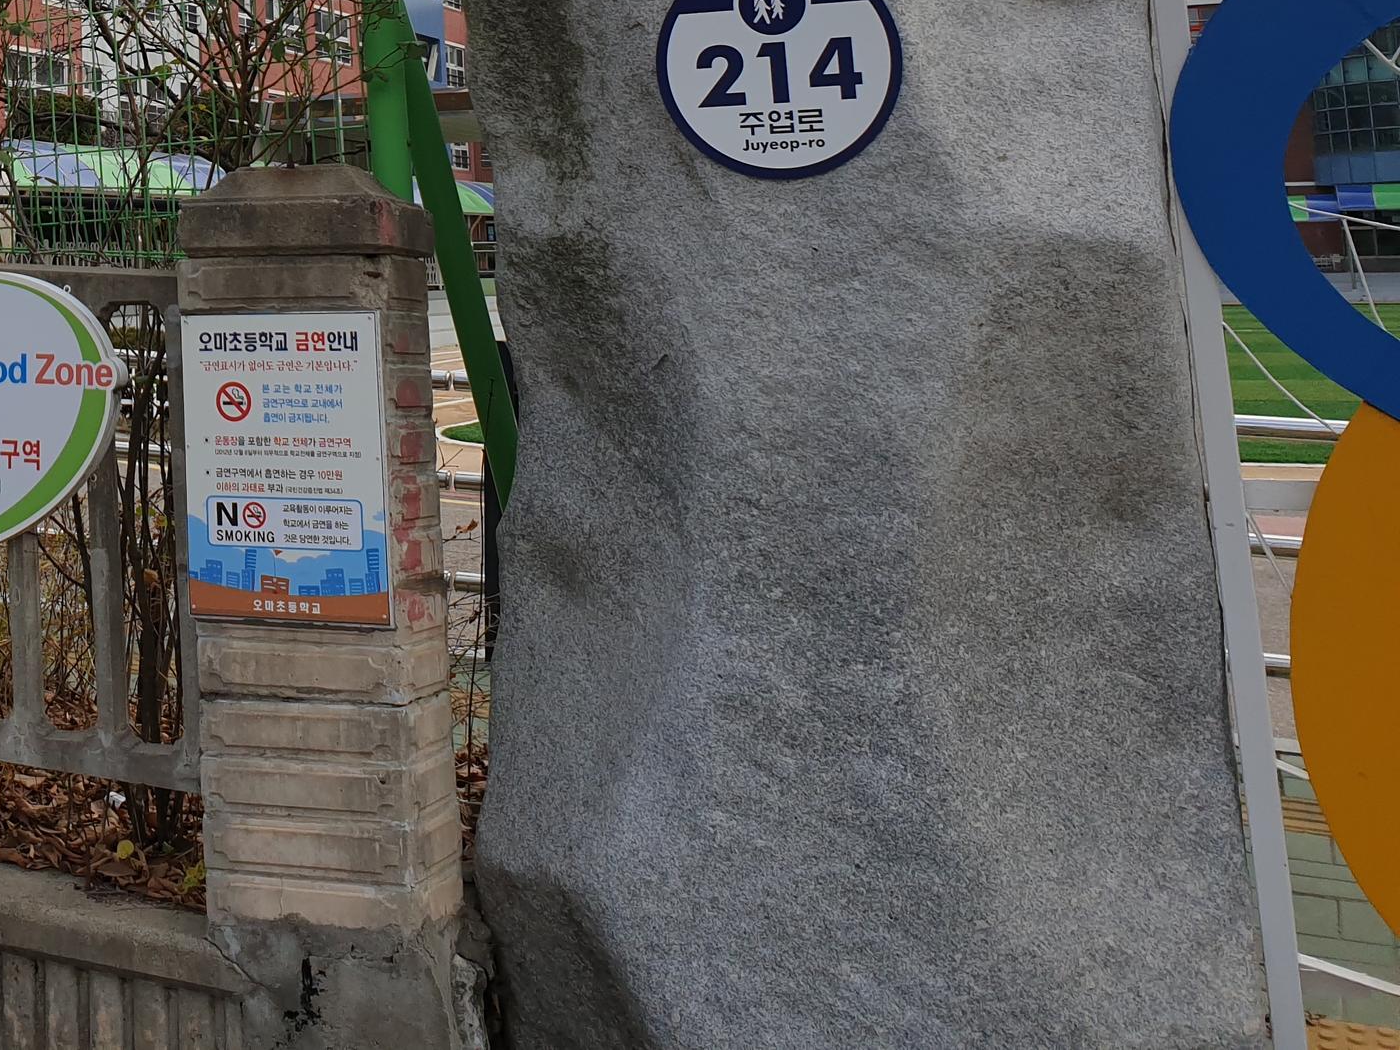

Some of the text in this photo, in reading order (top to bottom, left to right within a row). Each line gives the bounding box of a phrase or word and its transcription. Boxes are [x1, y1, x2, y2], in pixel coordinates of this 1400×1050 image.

[696, 36, 863, 108] 214
[739, 108, 825, 136] 주엽로
[742, 138, 826, 154] Juyeop-ro
[199, 331, 358, 352] 오마초등학교 금연안내
[35, 353, 113, 388] Zone
[294, 384, 312, 394] 학교
[273, 437, 289, 447] 학교
[318, 437, 352, 448] 금연구역
[216, 468, 343, 481] 금연구역에서 흡연하는 경우 10만원
[216, 482, 239, 493] 이하의
[267, 483, 283, 494] 부과
[216, 530, 275, 543] SMOKING
[253, 600, 321, 614] 오마초등학교
